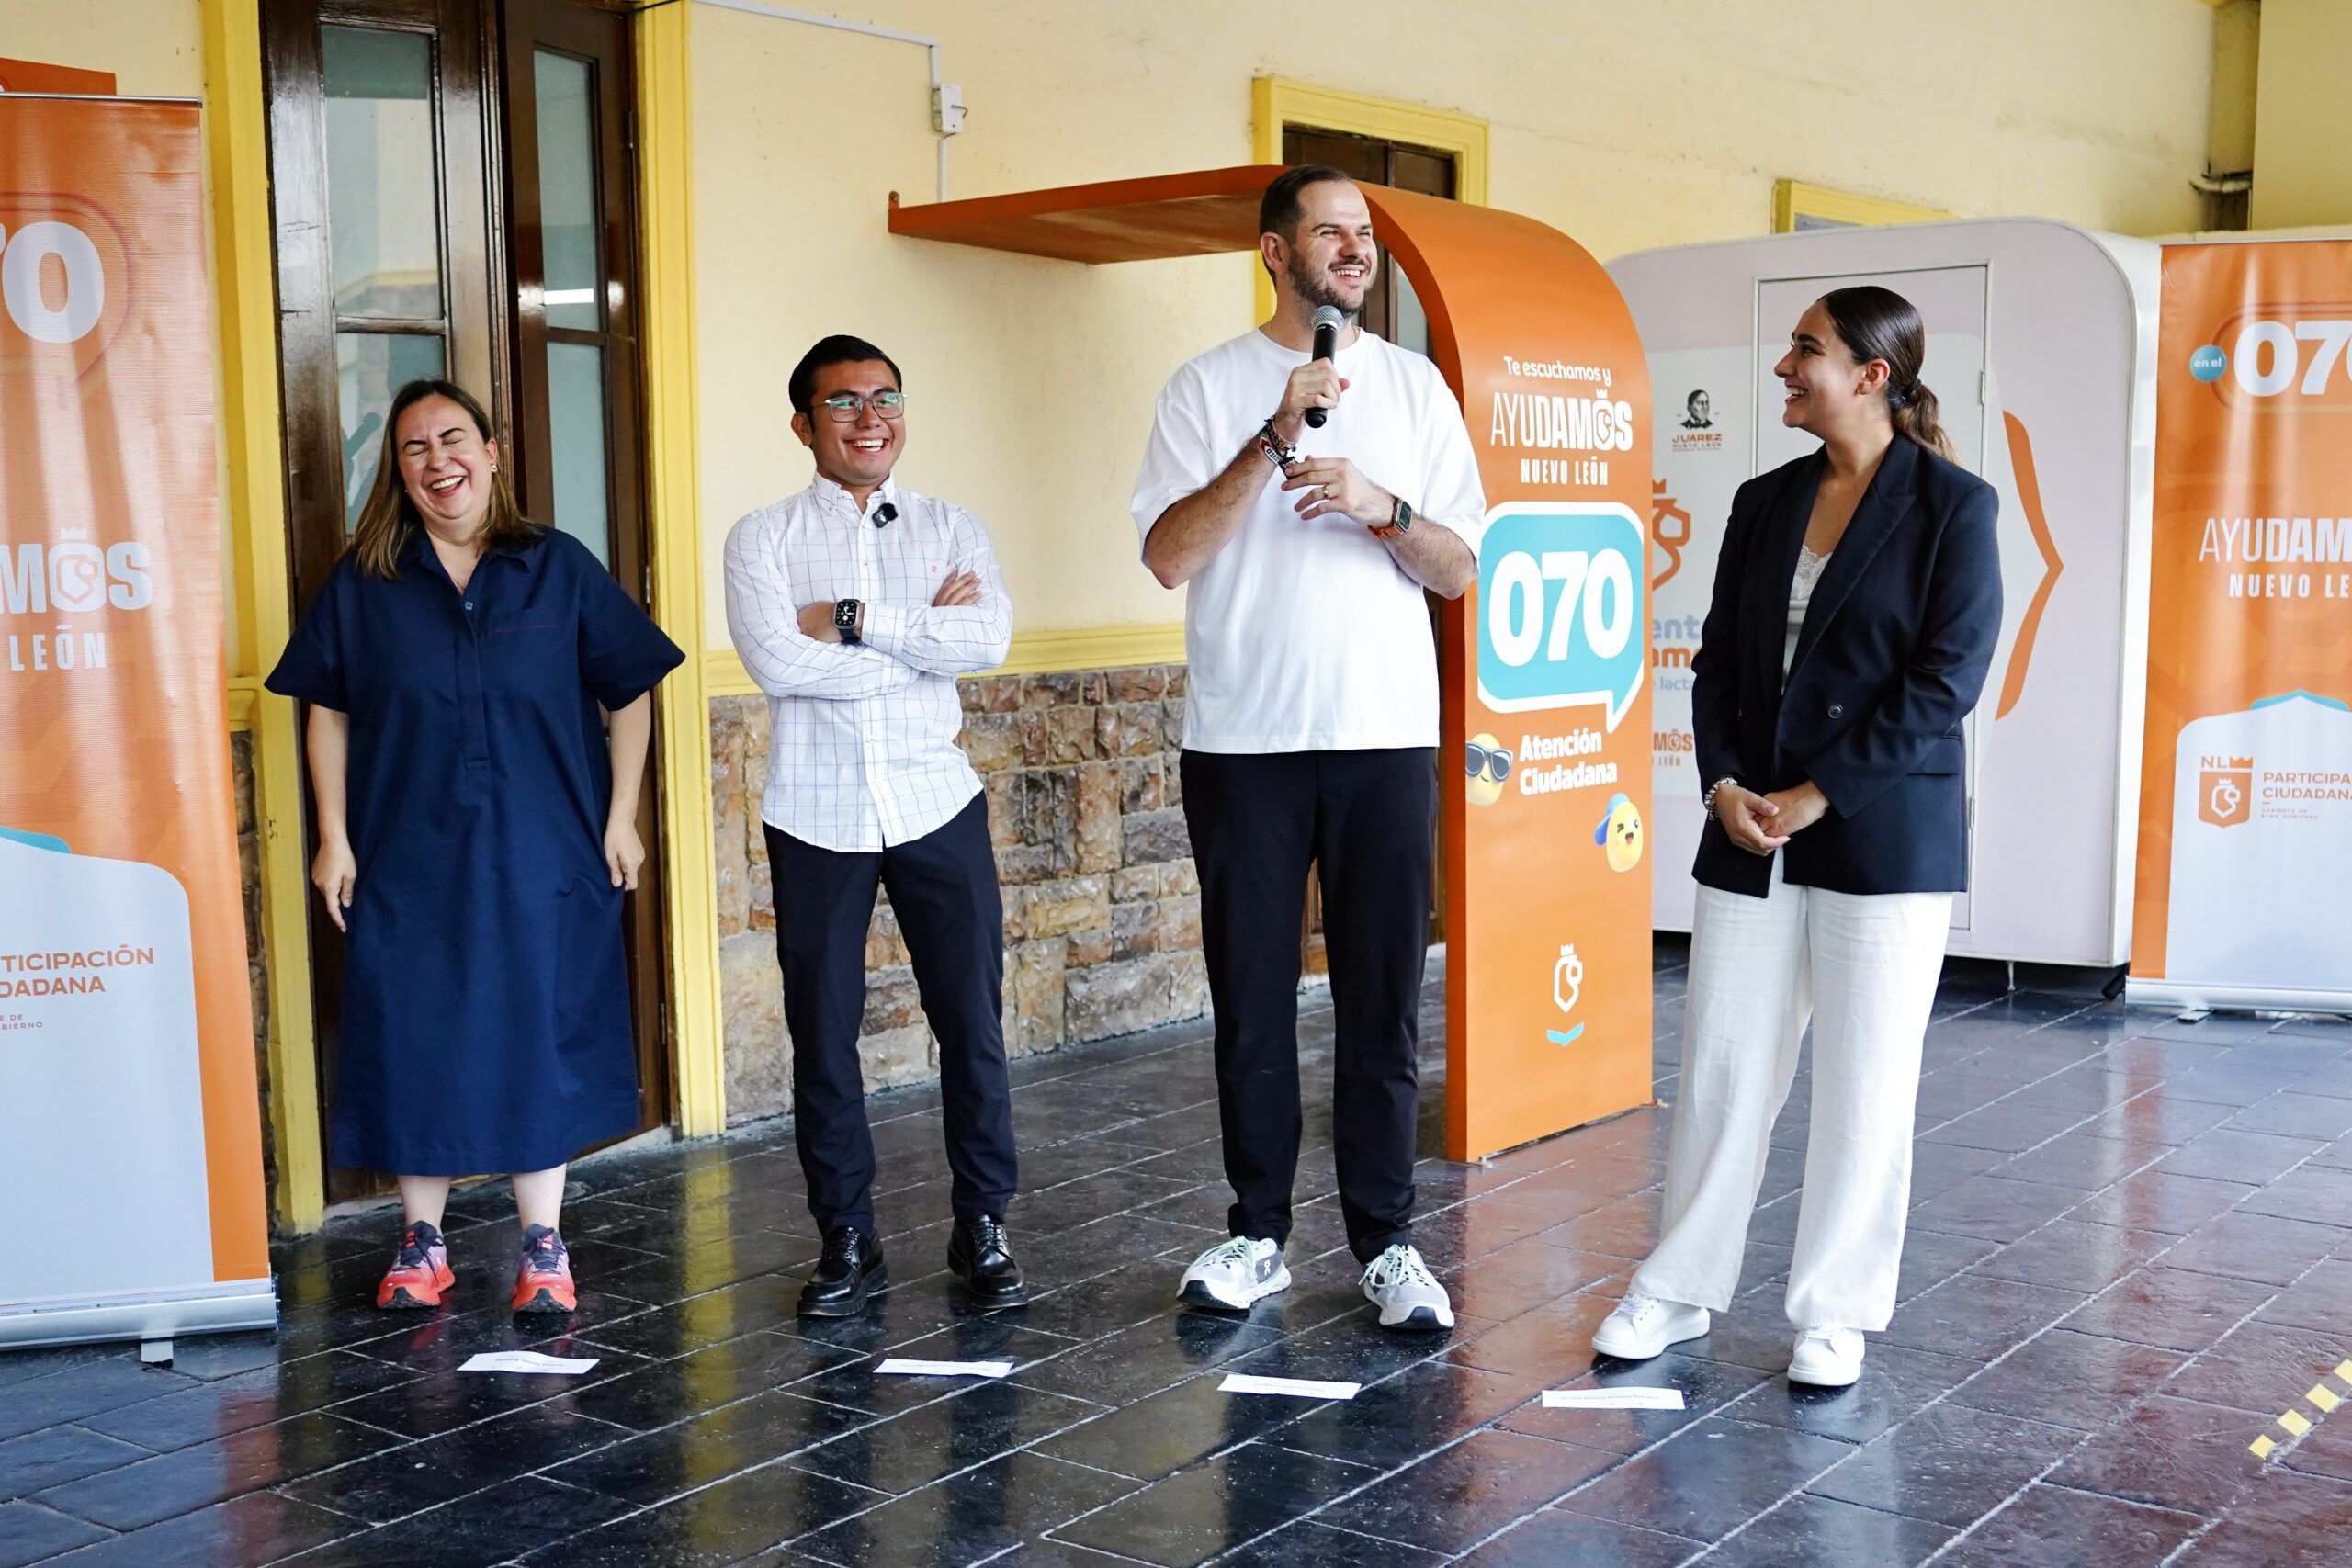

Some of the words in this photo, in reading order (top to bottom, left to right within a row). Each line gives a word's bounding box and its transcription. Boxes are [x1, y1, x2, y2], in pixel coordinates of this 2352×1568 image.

[0, 221, 104, 344] 0
[1503, 355, 1521, 376] Te
[1523, 360, 1601, 382] escuchamos
[1602, 368, 1612, 387] y
[2194, 359, 2209, 368] en
[2211, 356, 2222, 367] el
[2233, 320, 2352, 397] 07
[1490, 391, 1633, 451] AYUDAMOS
[1521, 459, 1567, 484] NUEVO
[1575, 456, 1608, 485] LEÓN
[2229, 573, 2311, 598] NUEVO
[1488, 548, 1634, 667] 070
[9, 624, 107, 671] LEÓN
[1519, 727, 1602, 762] Atención
[1520, 761, 1617, 795] Ciudadana
[2200, 756, 2228, 769] NL
[2263, 772, 2351, 784] PARTICIPA
[2262, 787, 2352, 800] CIUDADAN
